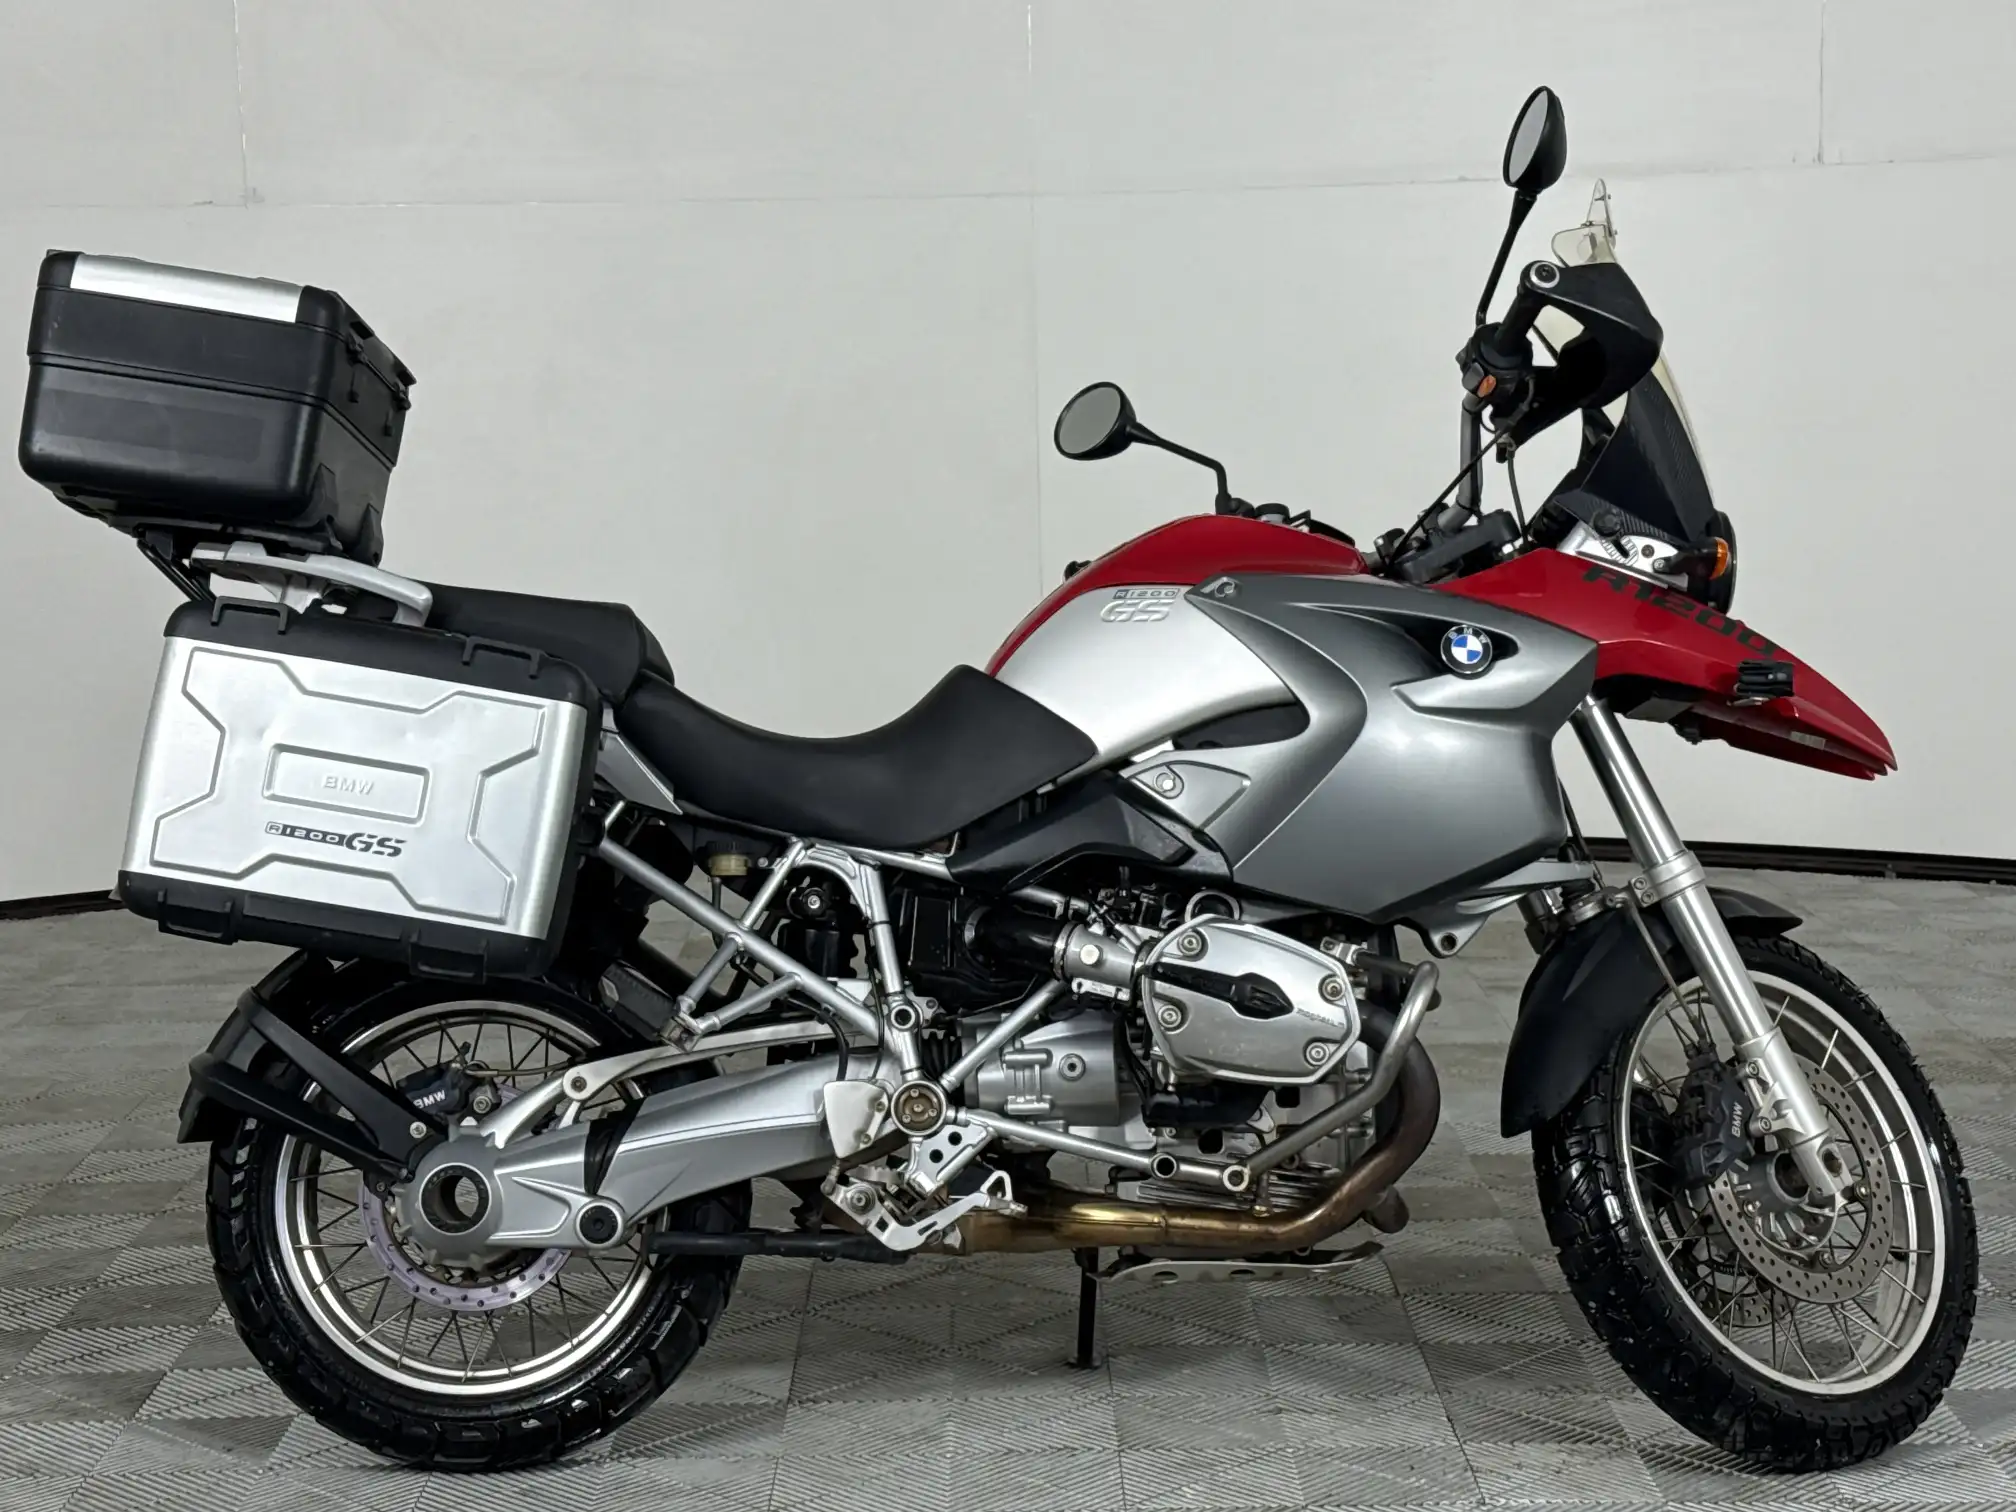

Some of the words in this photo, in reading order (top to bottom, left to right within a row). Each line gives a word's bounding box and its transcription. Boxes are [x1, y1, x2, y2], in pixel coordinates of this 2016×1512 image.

[1113, 588, 1179, 600] R1200
[1100, 599, 1175, 622] GS
[1448, 627, 1488, 644] BMW
[322, 775, 375, 796] BMW
[1731, 1101, 1743, 1138] BMW
